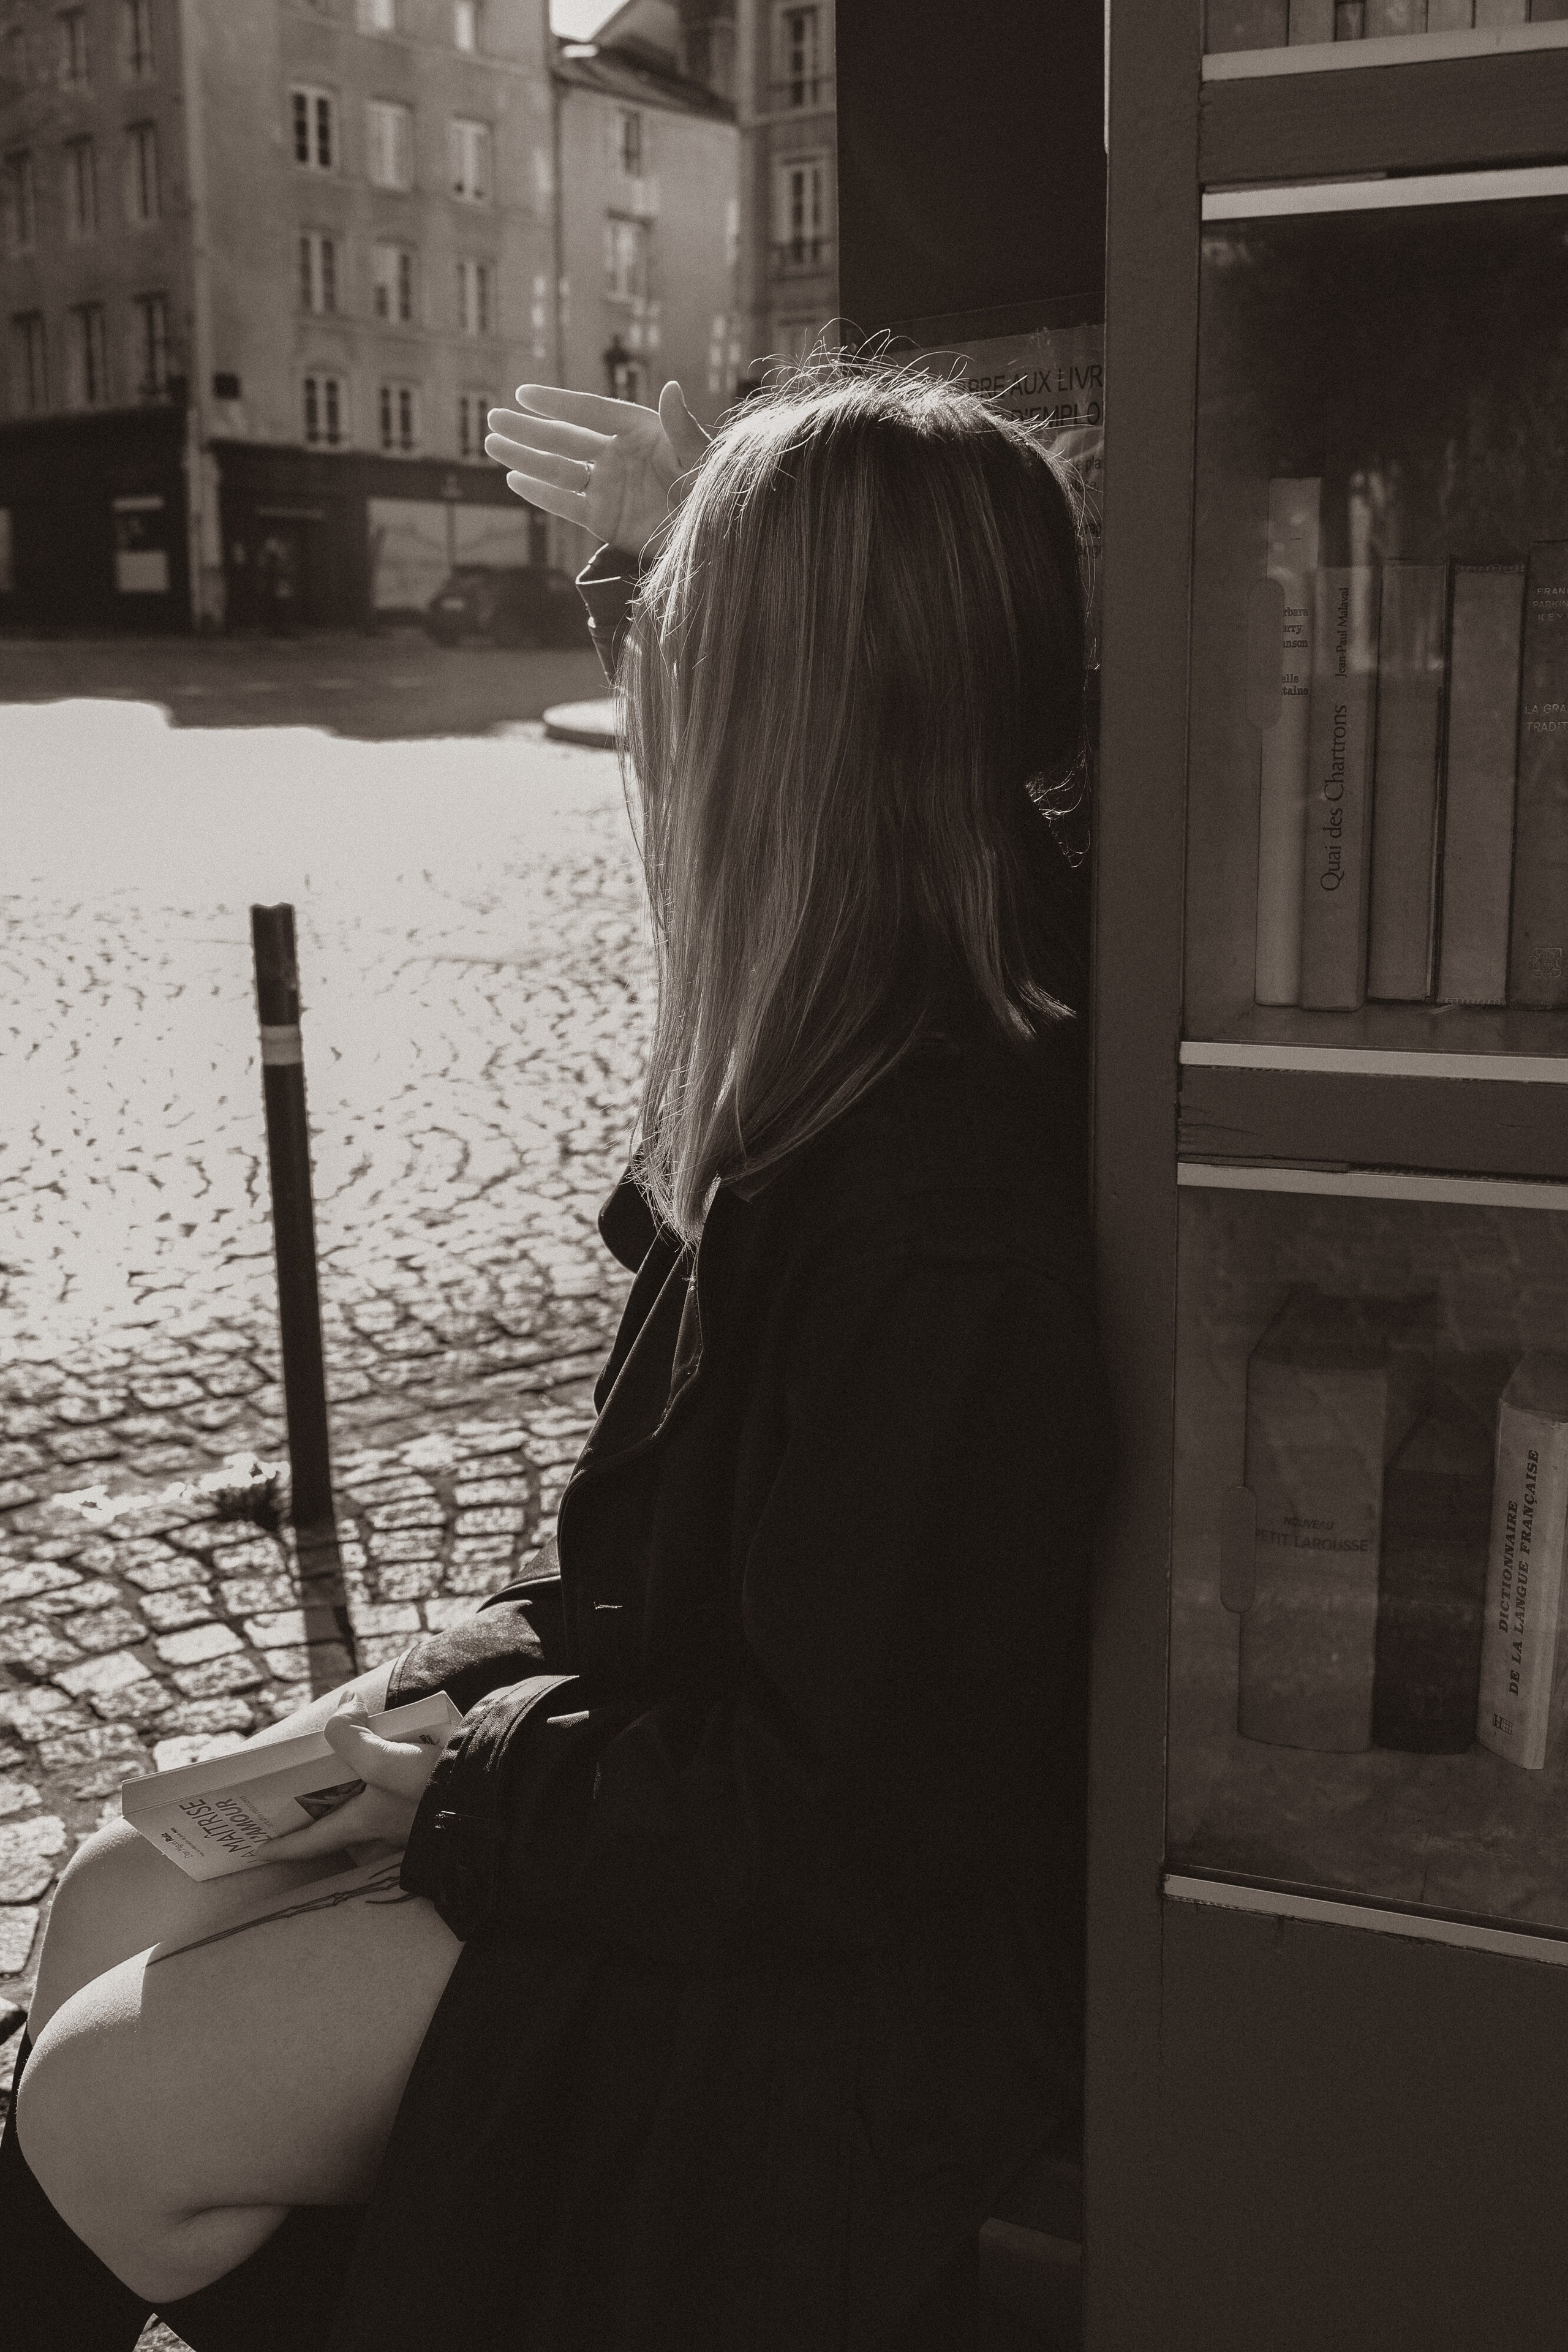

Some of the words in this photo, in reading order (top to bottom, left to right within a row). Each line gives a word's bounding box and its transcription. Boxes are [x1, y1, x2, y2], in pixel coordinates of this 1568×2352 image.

[968, 374, 1005, 399] BRE
[1010, 370, 1052, 396] AUX
[1058, 364, 1103, 392] LIVR
[1011, 401, 1101, 428] D'EMPLO
[1085, 453, 1103, 473] pla
[1284, 606, 1309, 617] rbara
[1337, 587, 1349, 627] Malaval
[1538, 613, 1567, 622] KEY
[1283, 625, 1303, 635] rry
[1335, 630, 1348, 678] Jean-Paul
[1281, 673, 1299, 684] elle
[1281, 685, 1310, 696] taine
[1525, 704, 1539, 714] LA
[1544, 704, 1567, 714] GRA
[1526, 722, 1568, 732] TRADIT
[1324, 704, 1348, 802] Chartrons
[1322, 807, 1343, 839] des
[1320, 845, 1345, 891] Quai
[1520, 1449, 1539, 1555] FRANÇAISE
[1283, 1515, 1335, 1531] NOUVEAU
[1294, 1536, 1369, 1552] LAROUSSE
[1499, 1501, 1518, 1634] DICTIONNAIRE
[1513, 1561, 1529, 1635] LANGUE
[1512, 1642, 1523, 1665] LA
[1509, 1670, 1520, 1696] DE
[178, 1798, 252, 1853] MAÎTRISE
[215, 1798, 273, 1844] L'AMOUR
